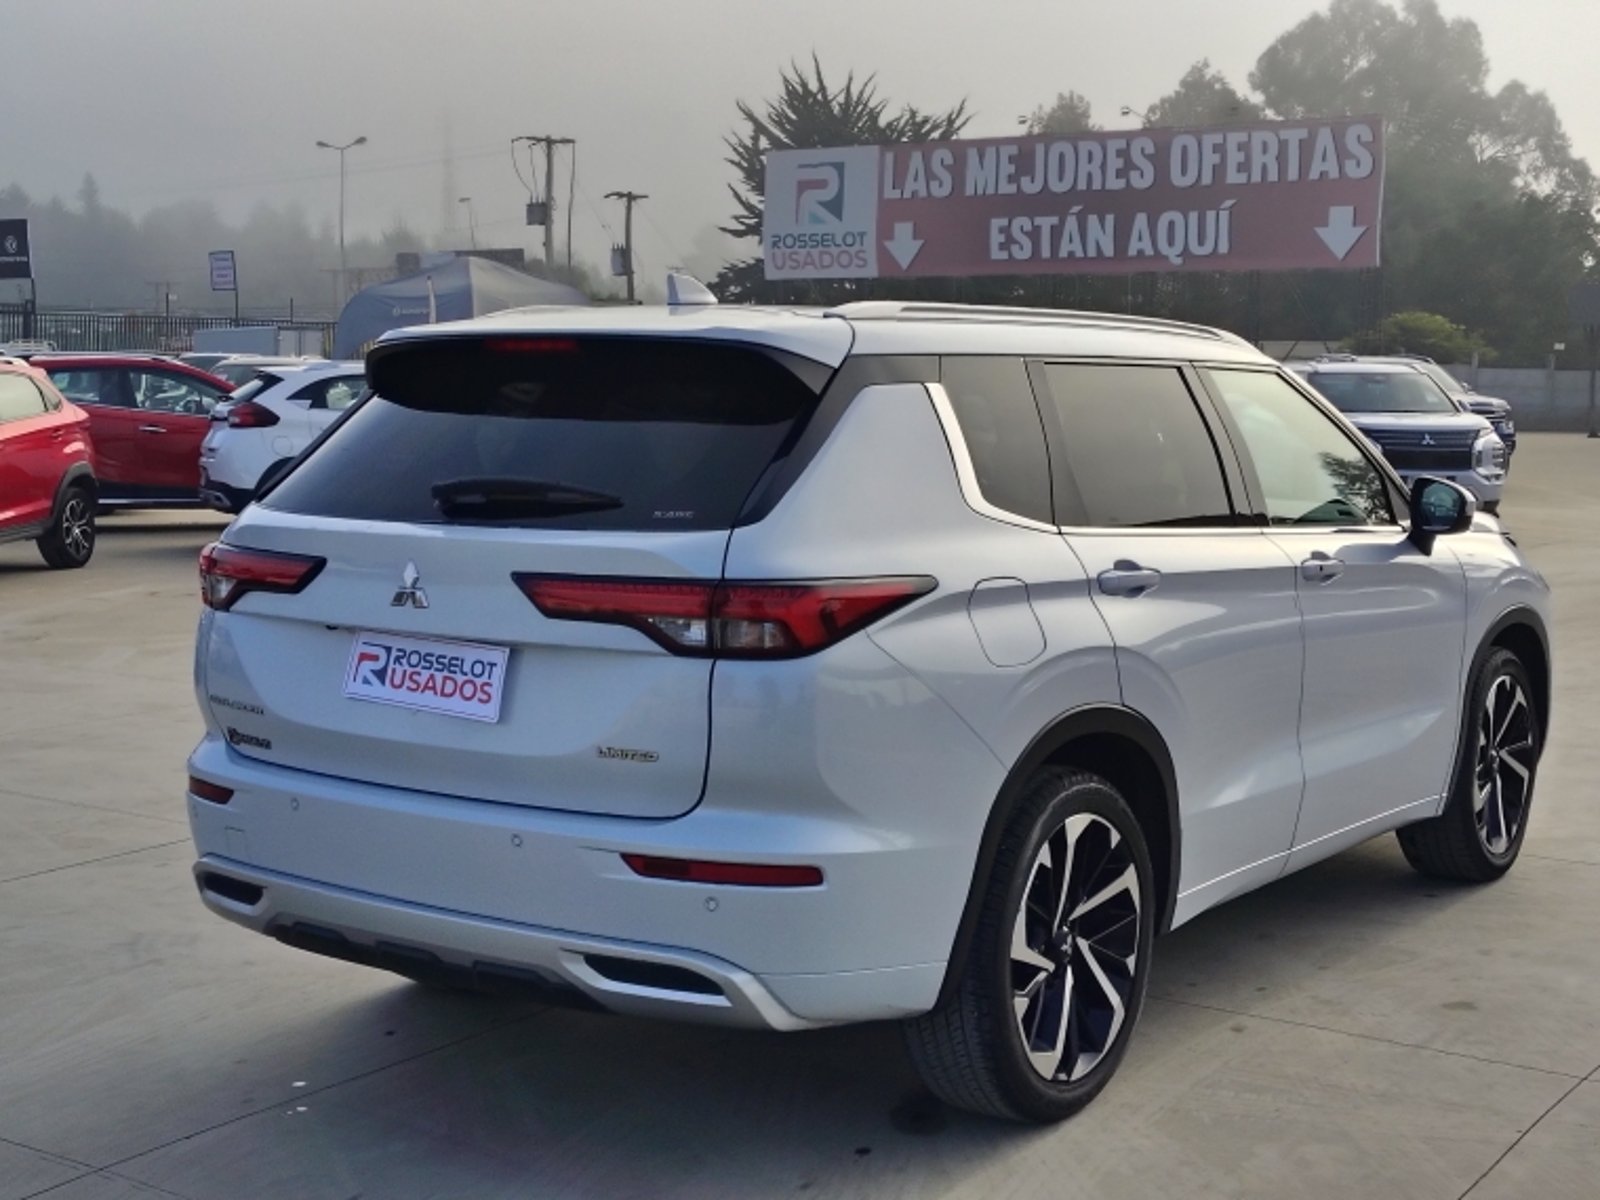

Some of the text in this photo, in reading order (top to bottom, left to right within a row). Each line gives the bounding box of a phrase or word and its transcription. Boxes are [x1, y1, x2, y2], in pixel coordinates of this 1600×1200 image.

[883, 124, 1375, 199] LAS MEJORES OFERTAS
[771, 231, 868, 250] ROSSELOT
[989, 199, 1239, 266] ESTÁN AQUÍ
[771, 250, 868, 271] USADOS
[393, 648, 498, 681] ROSSELOT
[389, 669, 494, 705] USADOS
